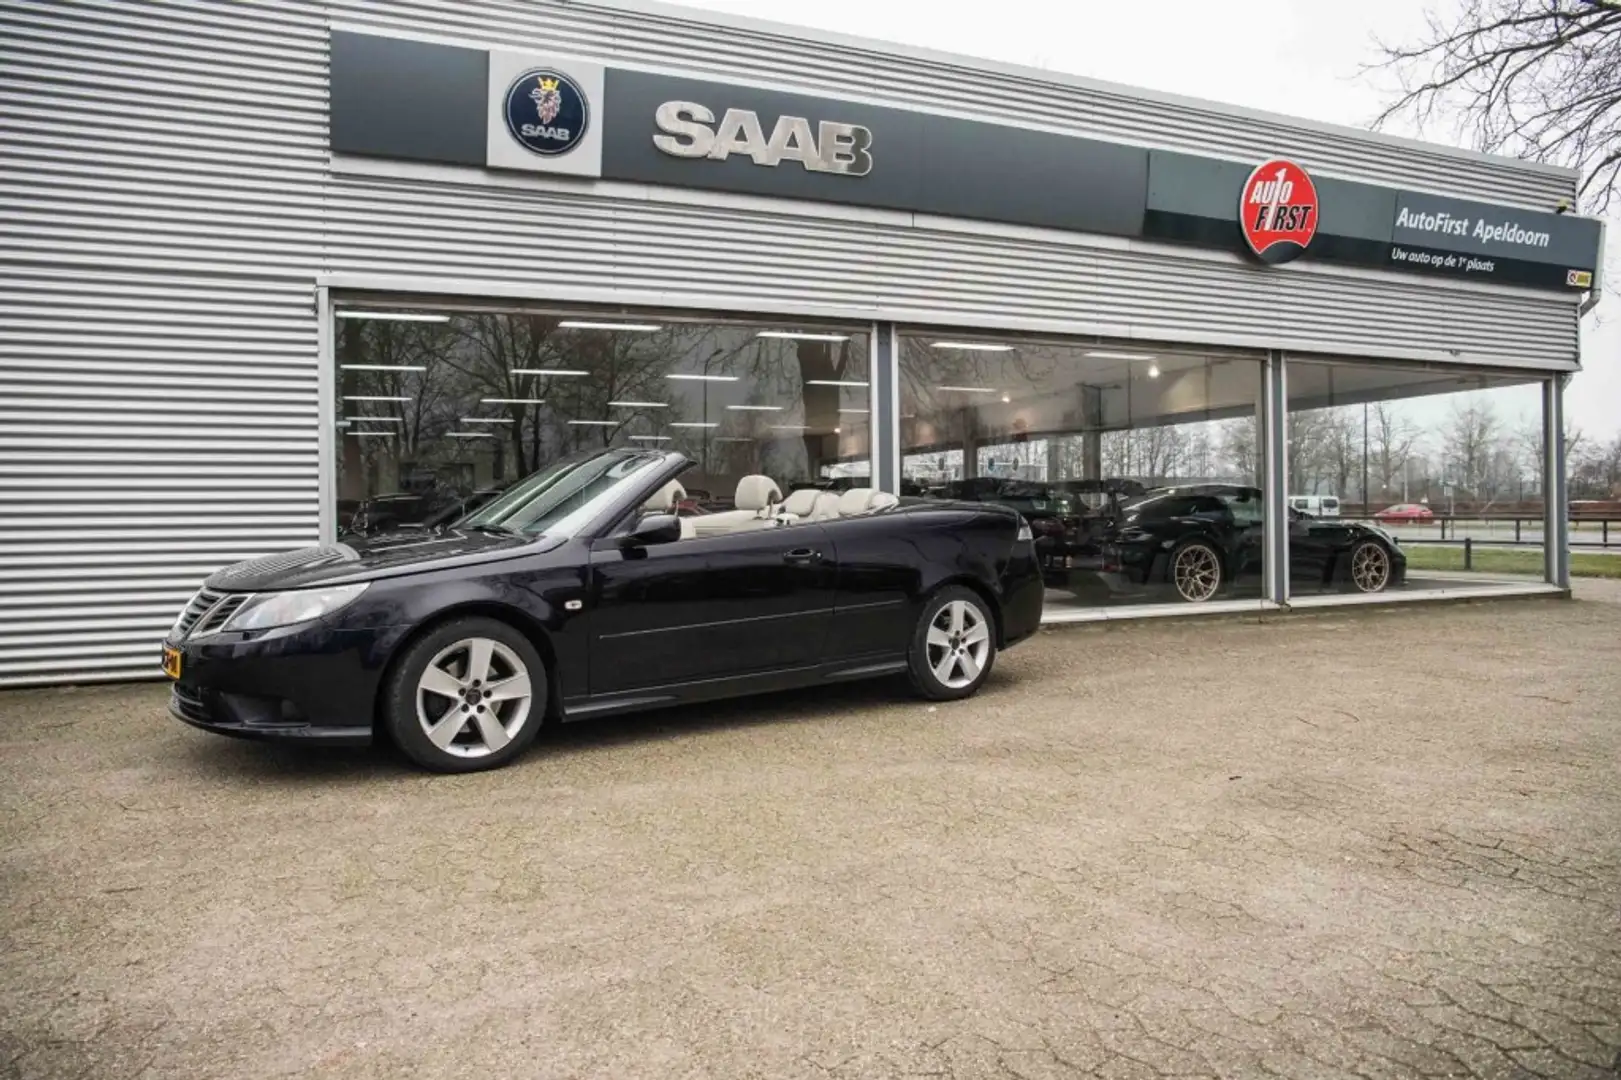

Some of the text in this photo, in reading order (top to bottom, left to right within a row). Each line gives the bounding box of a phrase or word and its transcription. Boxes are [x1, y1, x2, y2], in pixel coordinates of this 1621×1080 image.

[521, 123, 570, 141] SAAB
[653, 100, 873, 176] SAAB
[1396, 207, 1550, 248] AutoFirst Apeldoorn
[1391, 248, 1408, 261] Uw
[1408, 252, 1431, 264] auto
[1431, 255, 1443, 268] op
[1445, 254, 1457, 268] de
[1466, 258, 1495, 273] plaats
